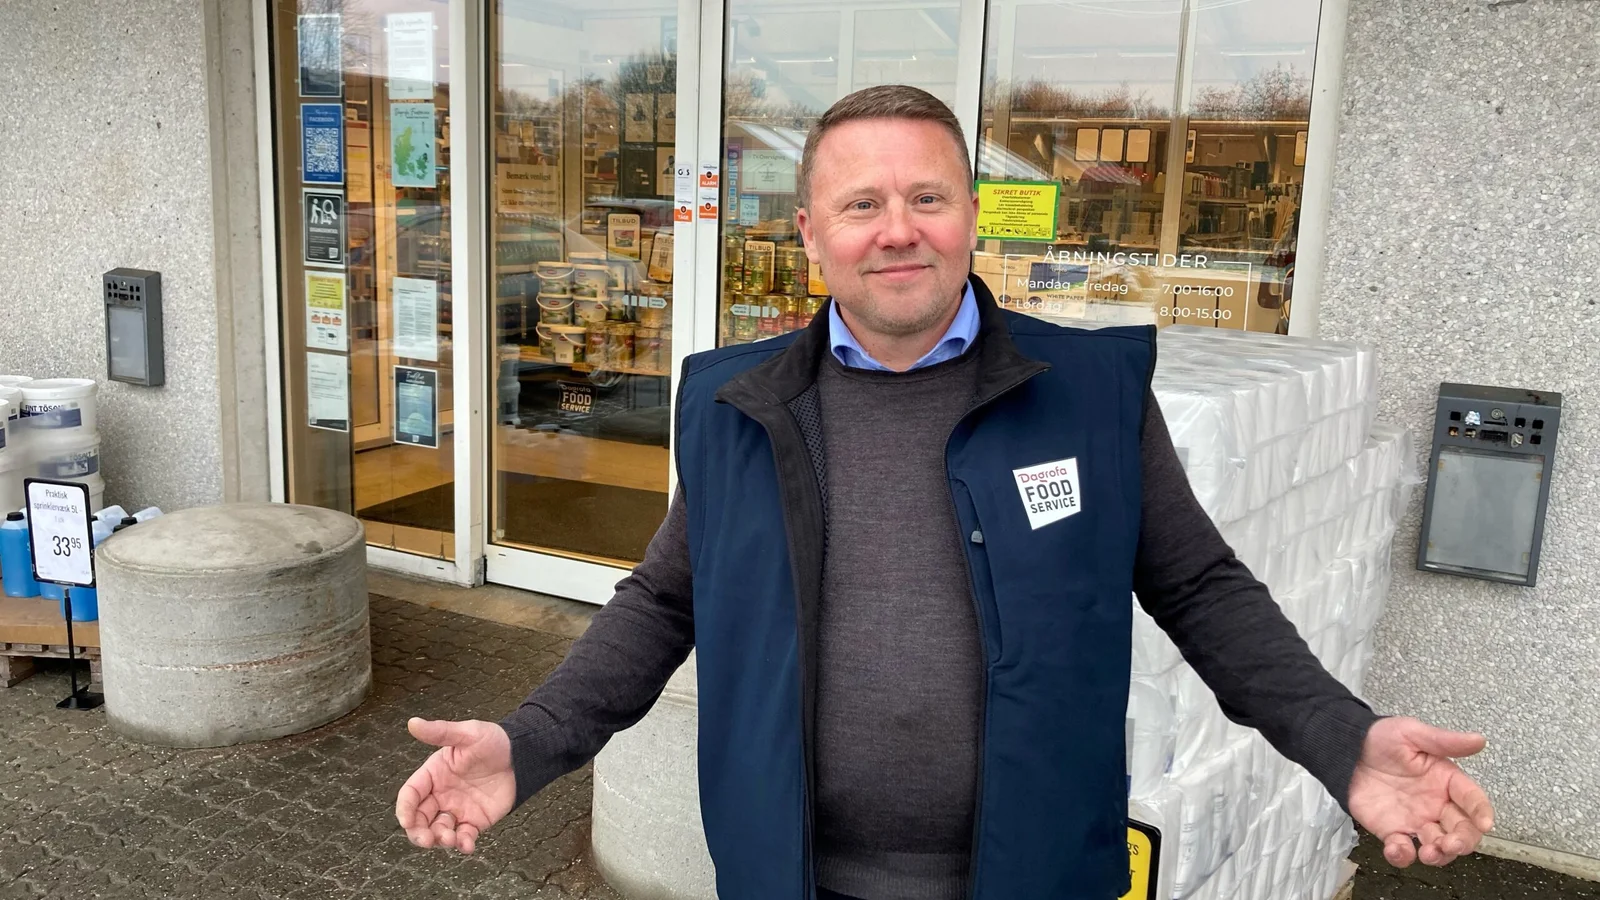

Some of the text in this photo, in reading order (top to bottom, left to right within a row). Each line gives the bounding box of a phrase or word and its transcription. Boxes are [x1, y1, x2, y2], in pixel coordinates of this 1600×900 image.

[1044, 246, 1208, 268] ÅBNINGSTIDER
[1017, 278, 1070, 292] Mandag
[1084, 280, 1128, 294] fredag
[1162, 283, 1234, 297] 7.00-16.00
[1160, 306, 1232, 320] 8.00-15.00
[560, 384, 591, 394] Dagrofa
[562, 392, 592, 406] FOOD
[561, 403, 590, 413] SERVICE
[1018, 466, 1067, 483] Dagrofa
[46, 490, 68, 500] Praktisk
[1024, 479, 1072, 502] FOOD
[34, 502, 70, 513] sprinklervæsk
[1030, 497, 1076, 513] SERVICE
